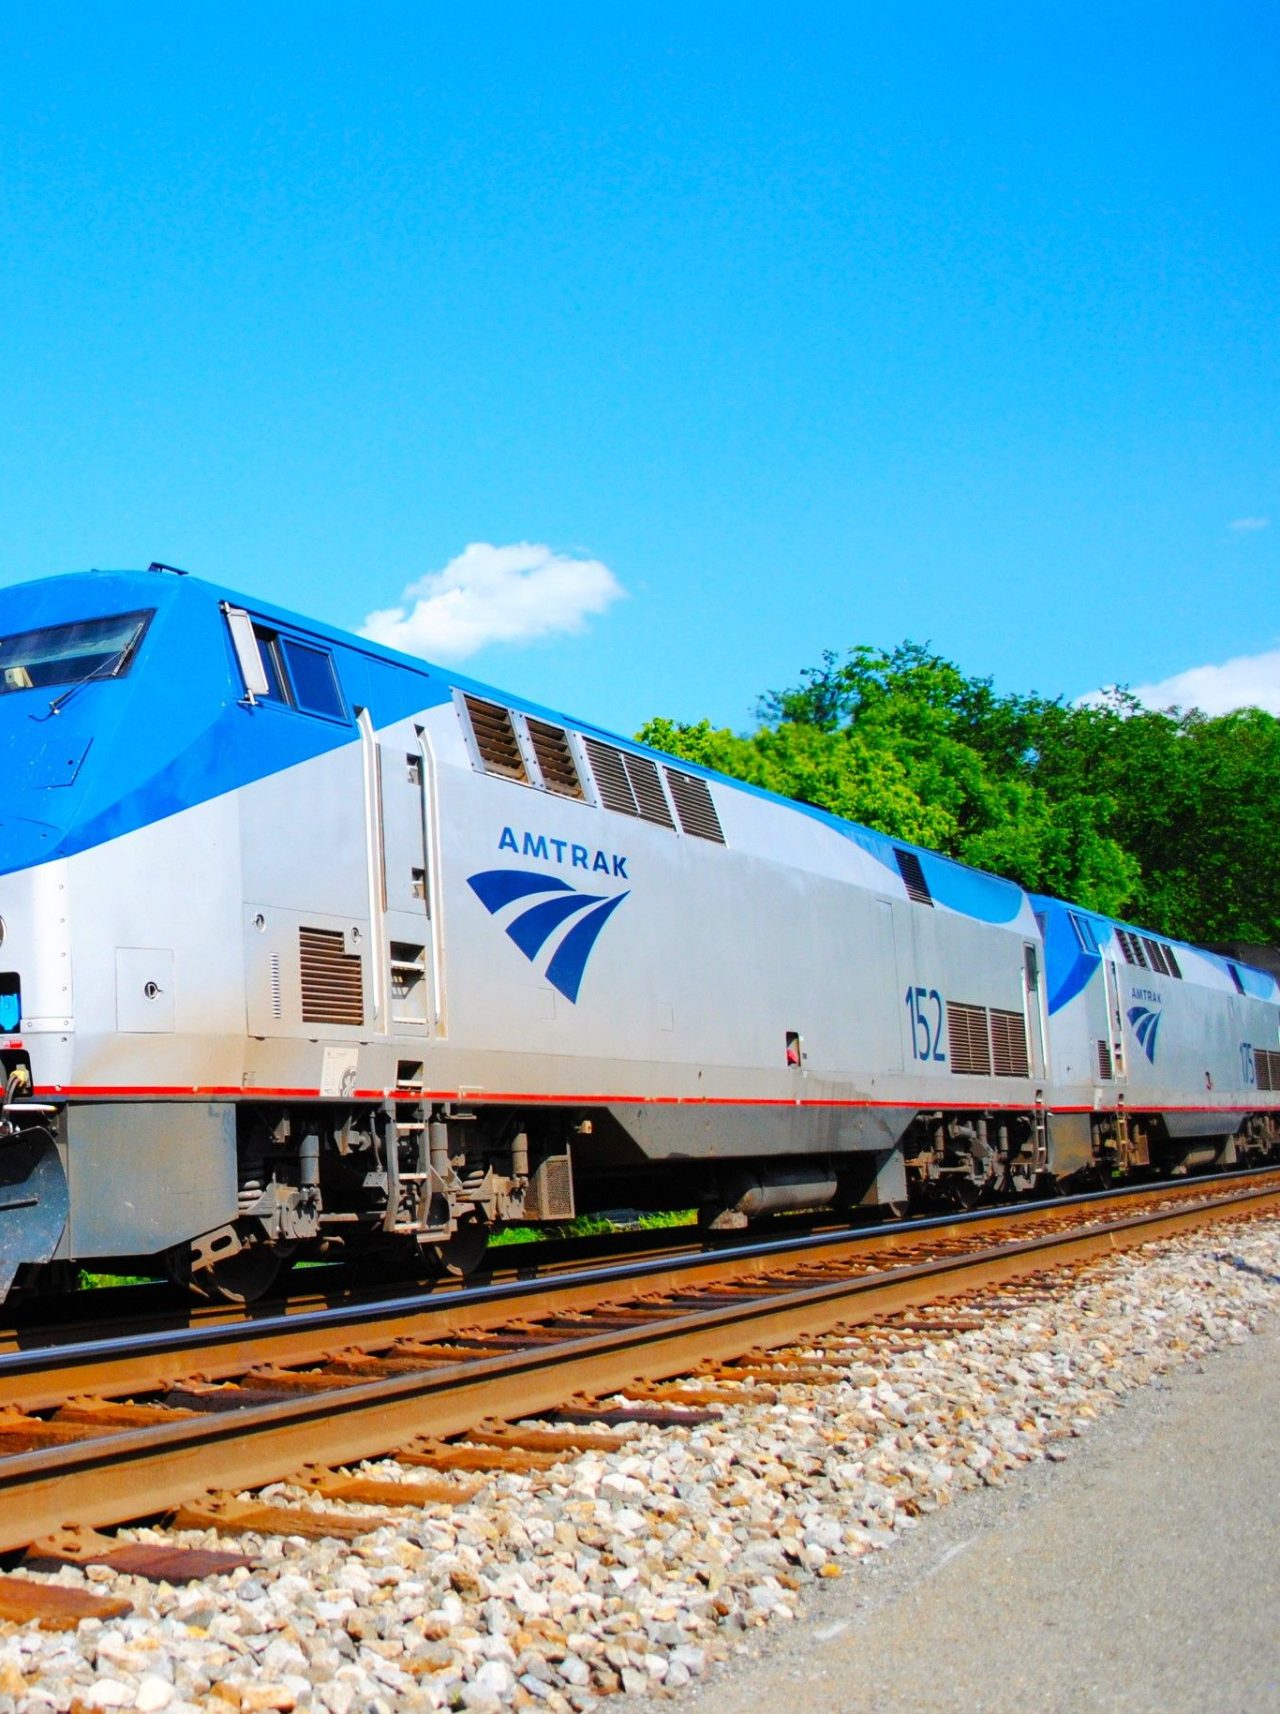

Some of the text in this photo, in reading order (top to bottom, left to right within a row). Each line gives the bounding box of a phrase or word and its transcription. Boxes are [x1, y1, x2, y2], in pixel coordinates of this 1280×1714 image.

[497, 826, 629, 880] AMTRAK
[1131, 986, 1162, 1004] AMTRAK
[905, 985, 946, 1062] 152
